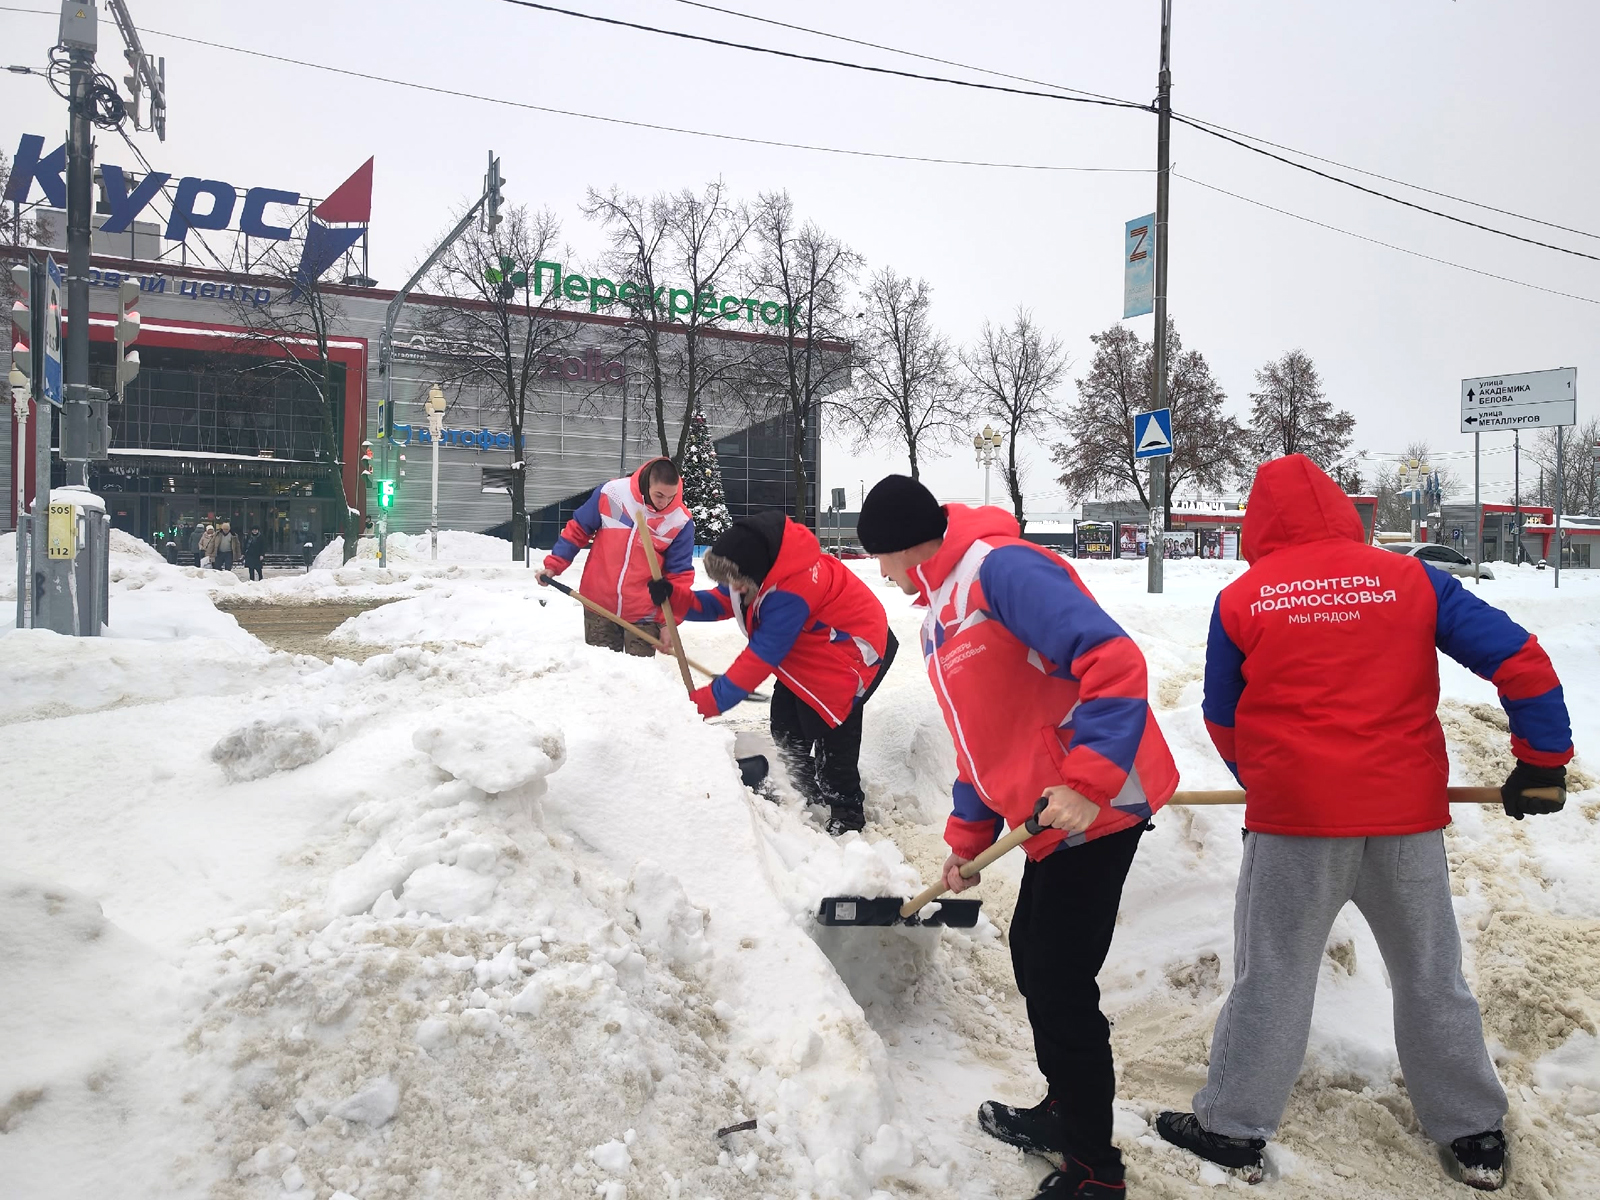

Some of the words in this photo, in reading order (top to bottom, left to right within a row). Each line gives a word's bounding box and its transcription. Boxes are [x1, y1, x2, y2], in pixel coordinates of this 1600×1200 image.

[1129, 225, 1148, 263] Z
[179, 280, 271, 308] центр
[534, 260, 803, 329] Перекрёсток
[1479, 380, 1503, 388] улица
[1566, 381, 1571, 389] 1
[1479, 384, 1531, 396] АКАДЕМИКА
[1479, 395, 1513, 405] БЕЛОВА
[1479, 410, 1503, 419] улица
[1479, 415, 1540, 426] МЕТАЛЛУРГОВ
[51, 506, 70, 515] SOS
[50, 547, 69, 556] 112
[1086, 544, 1111, 552] ЦВЕТЫ
[1260, 576, 1381, 597] ВОЛОНТЕРЫ
[1250, 590, 1397, 616] ПОДМОСКОВЬЯ
[1288, 613, 1311, 624] МЫ
[1314, 611, 1361, 623] РЯДОМ
